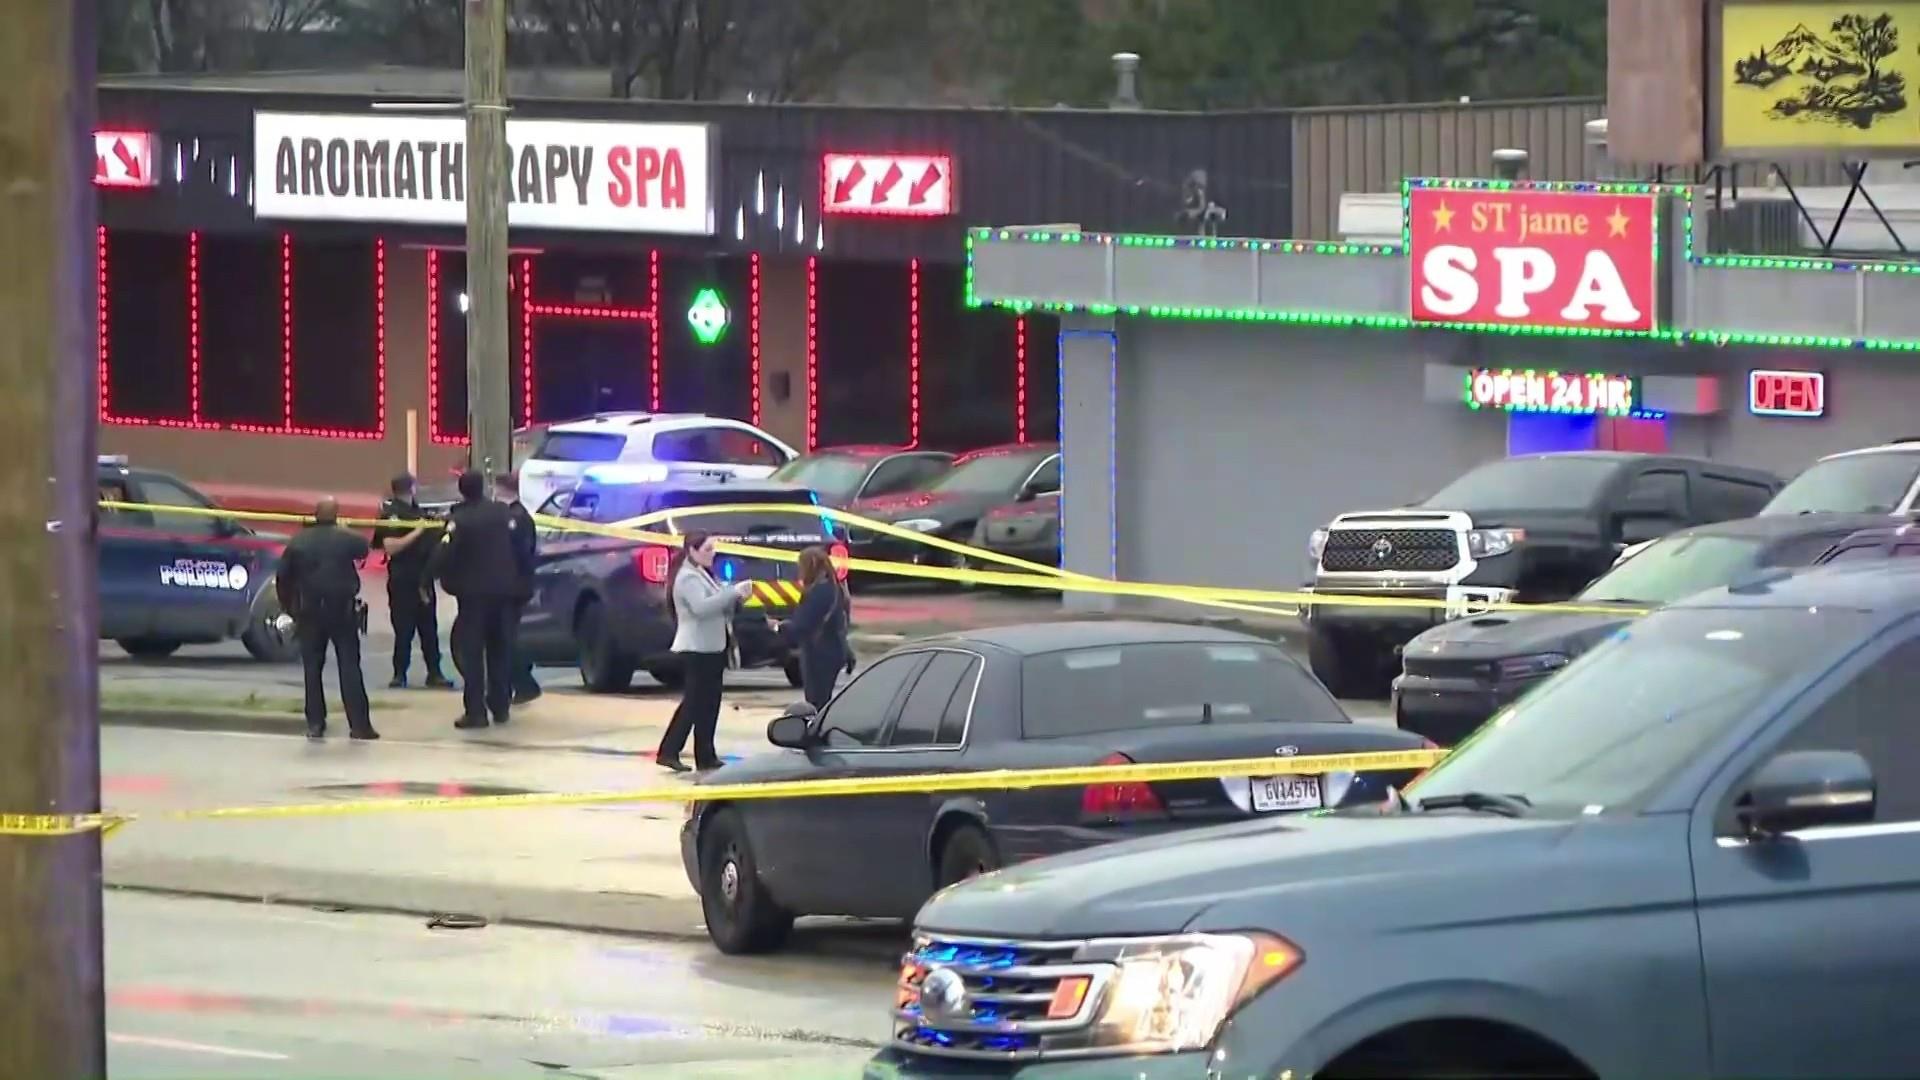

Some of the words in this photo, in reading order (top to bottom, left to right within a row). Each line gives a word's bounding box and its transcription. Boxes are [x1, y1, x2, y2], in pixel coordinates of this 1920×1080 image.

[607, 145, 687, 209] SPA
[1471, 202, 1511, 232] ST
[1519, 205, 1589, 243] jame
[1421, 244, 1641, 322] SPA
[1474, 374, 1546, 405] OPEN
[1552, 377, 1583, 407] 24
[1755, 376, 1819, 412] OPEN
